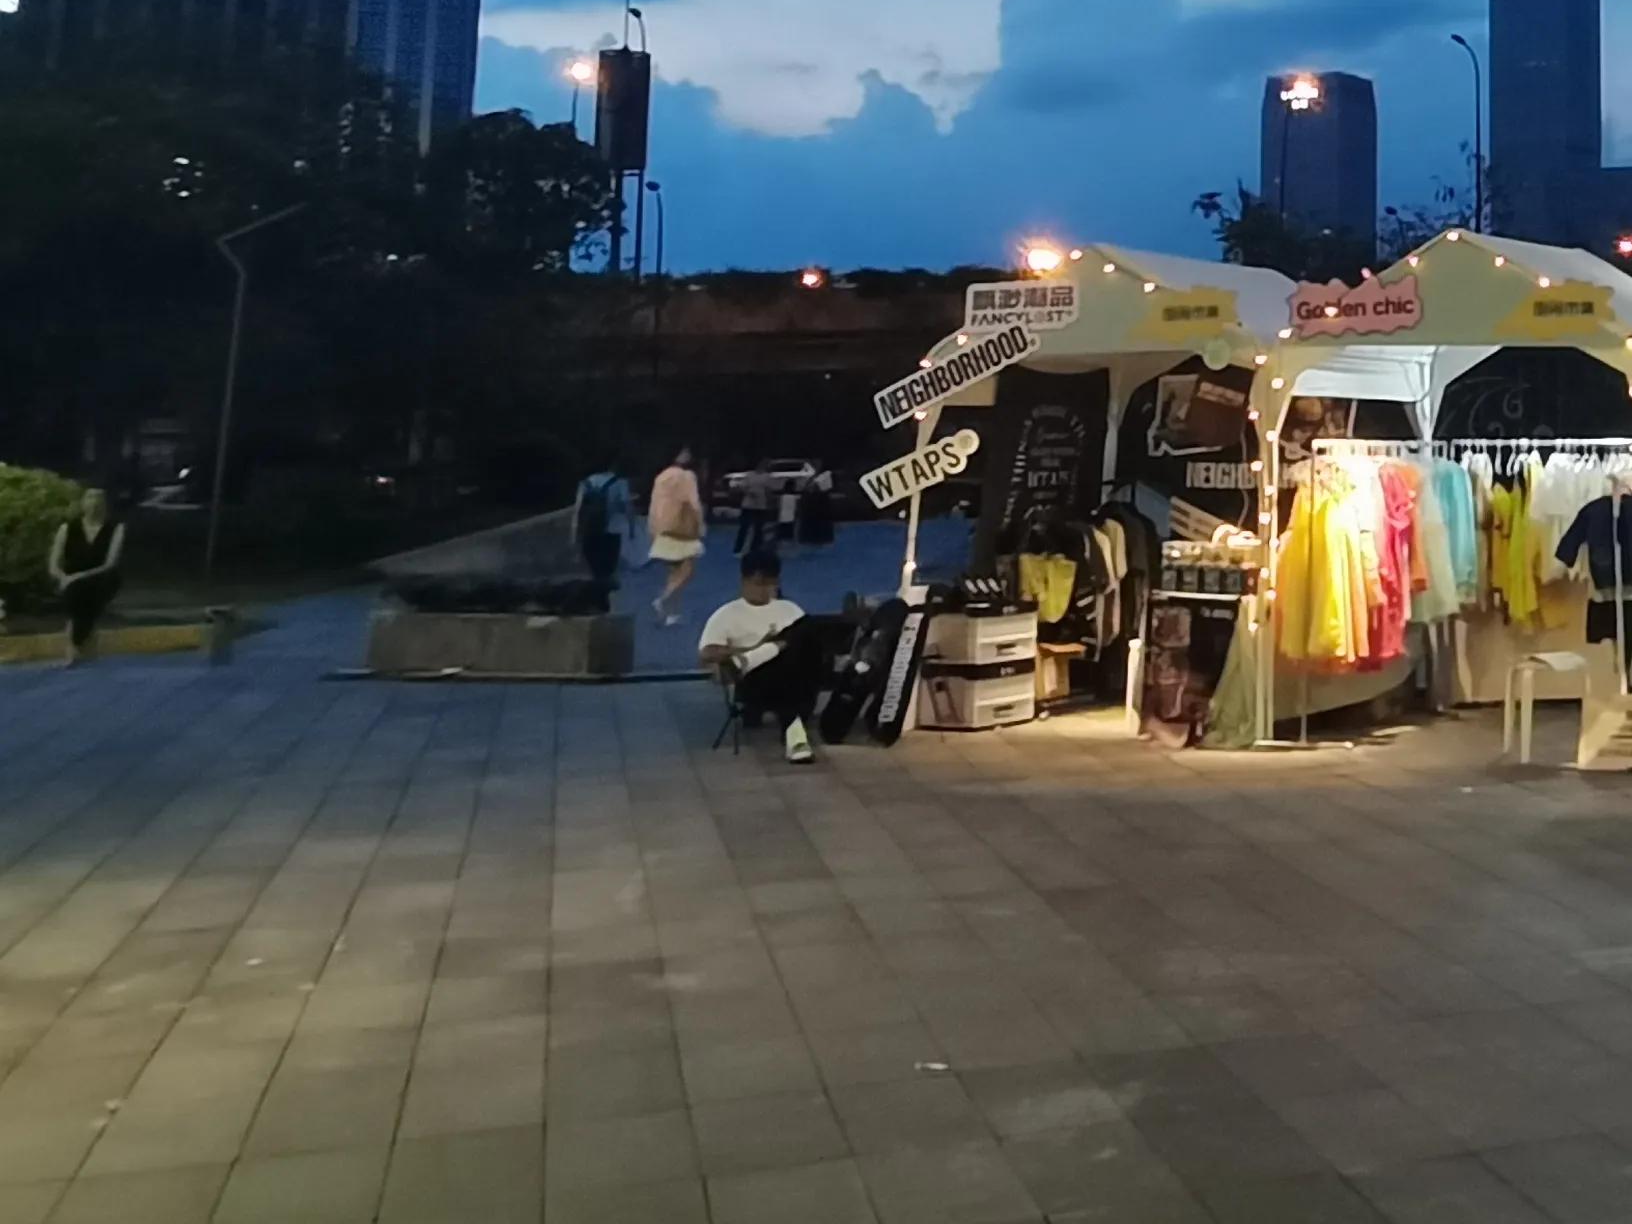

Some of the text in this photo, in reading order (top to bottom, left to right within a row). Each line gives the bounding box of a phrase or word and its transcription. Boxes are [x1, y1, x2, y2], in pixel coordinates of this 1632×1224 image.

[1297, 296, 1414, 320] Goden chic
[878, 326, 1029, 423] NEIGHBORHOOD
[867, 442, 961, 503] WTAPS
